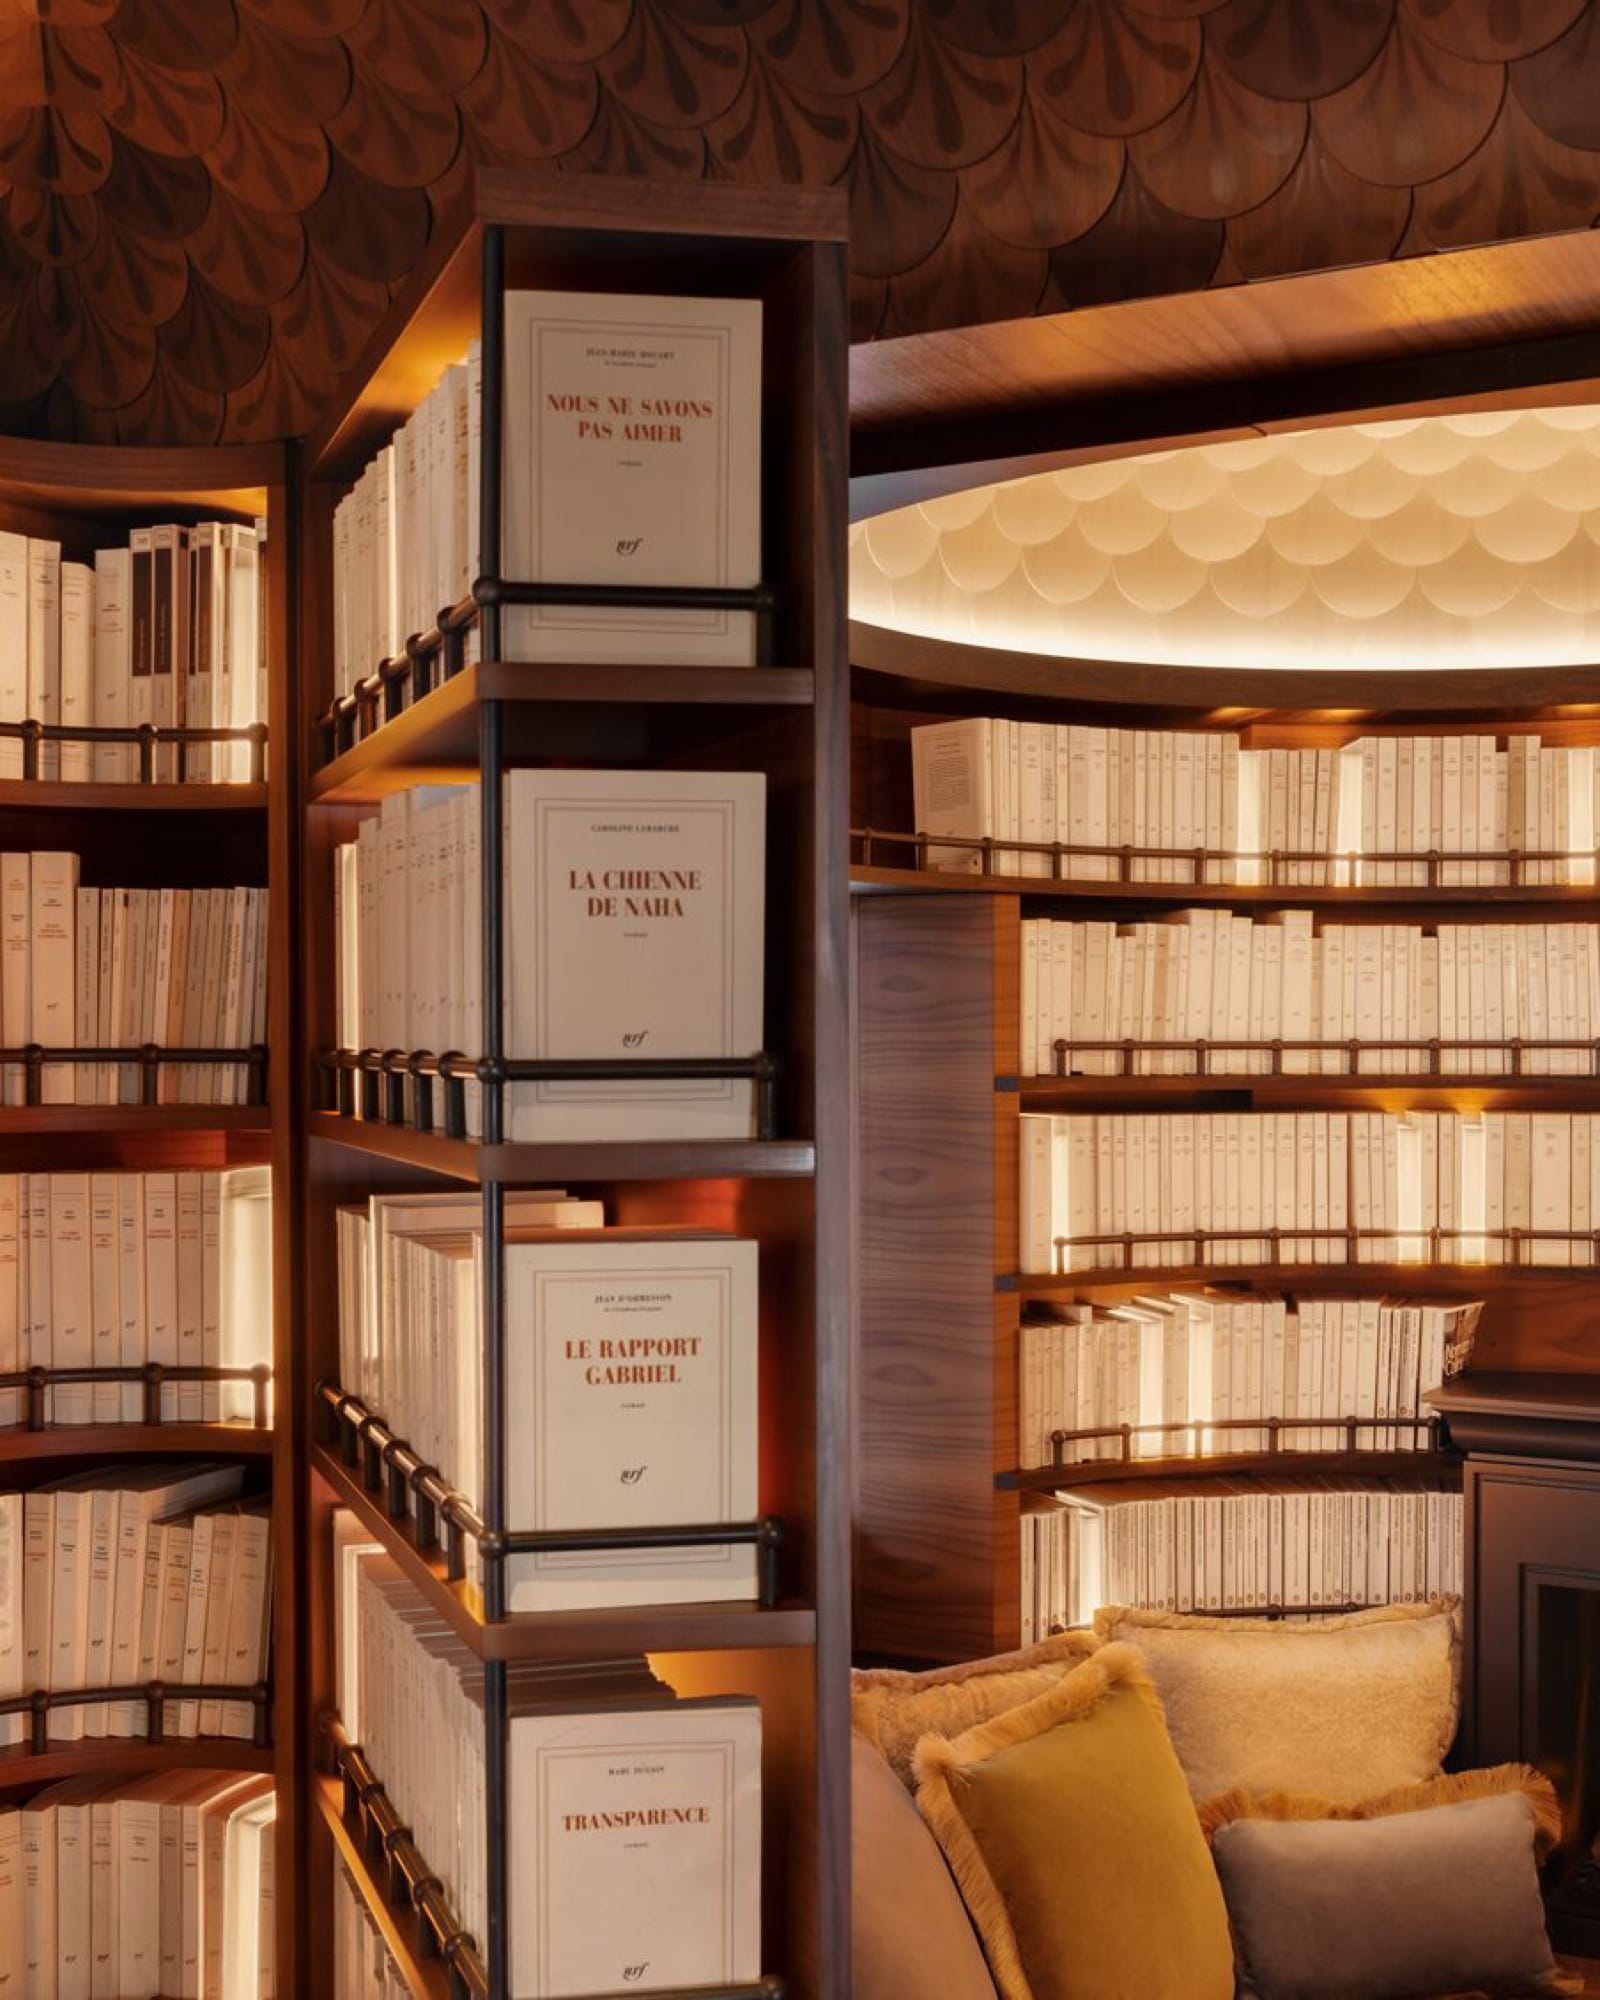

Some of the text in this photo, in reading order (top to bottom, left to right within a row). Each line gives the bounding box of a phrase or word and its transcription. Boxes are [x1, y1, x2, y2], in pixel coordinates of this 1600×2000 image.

[547, 394, 713, 419] NOUS NE SAVONS
[578, 420, 681, 443] PAS AIMER
[616, 537, 644, 557] nrf
[569, 870, 703, 891] LA CHIENNE
[587, 897, 618, 917] DE
[622, 1029, 649, 1049] nrf
[565, 1336, 703, 1360] LE RAPPORT
[585, 1364, 682, 1386] GABRIEL
[620, 1465, 648, 1485] nrf
[561, 1806, 711, 1832] TRANSPARENCE
[622, 1961, 650, 1982] nrf
